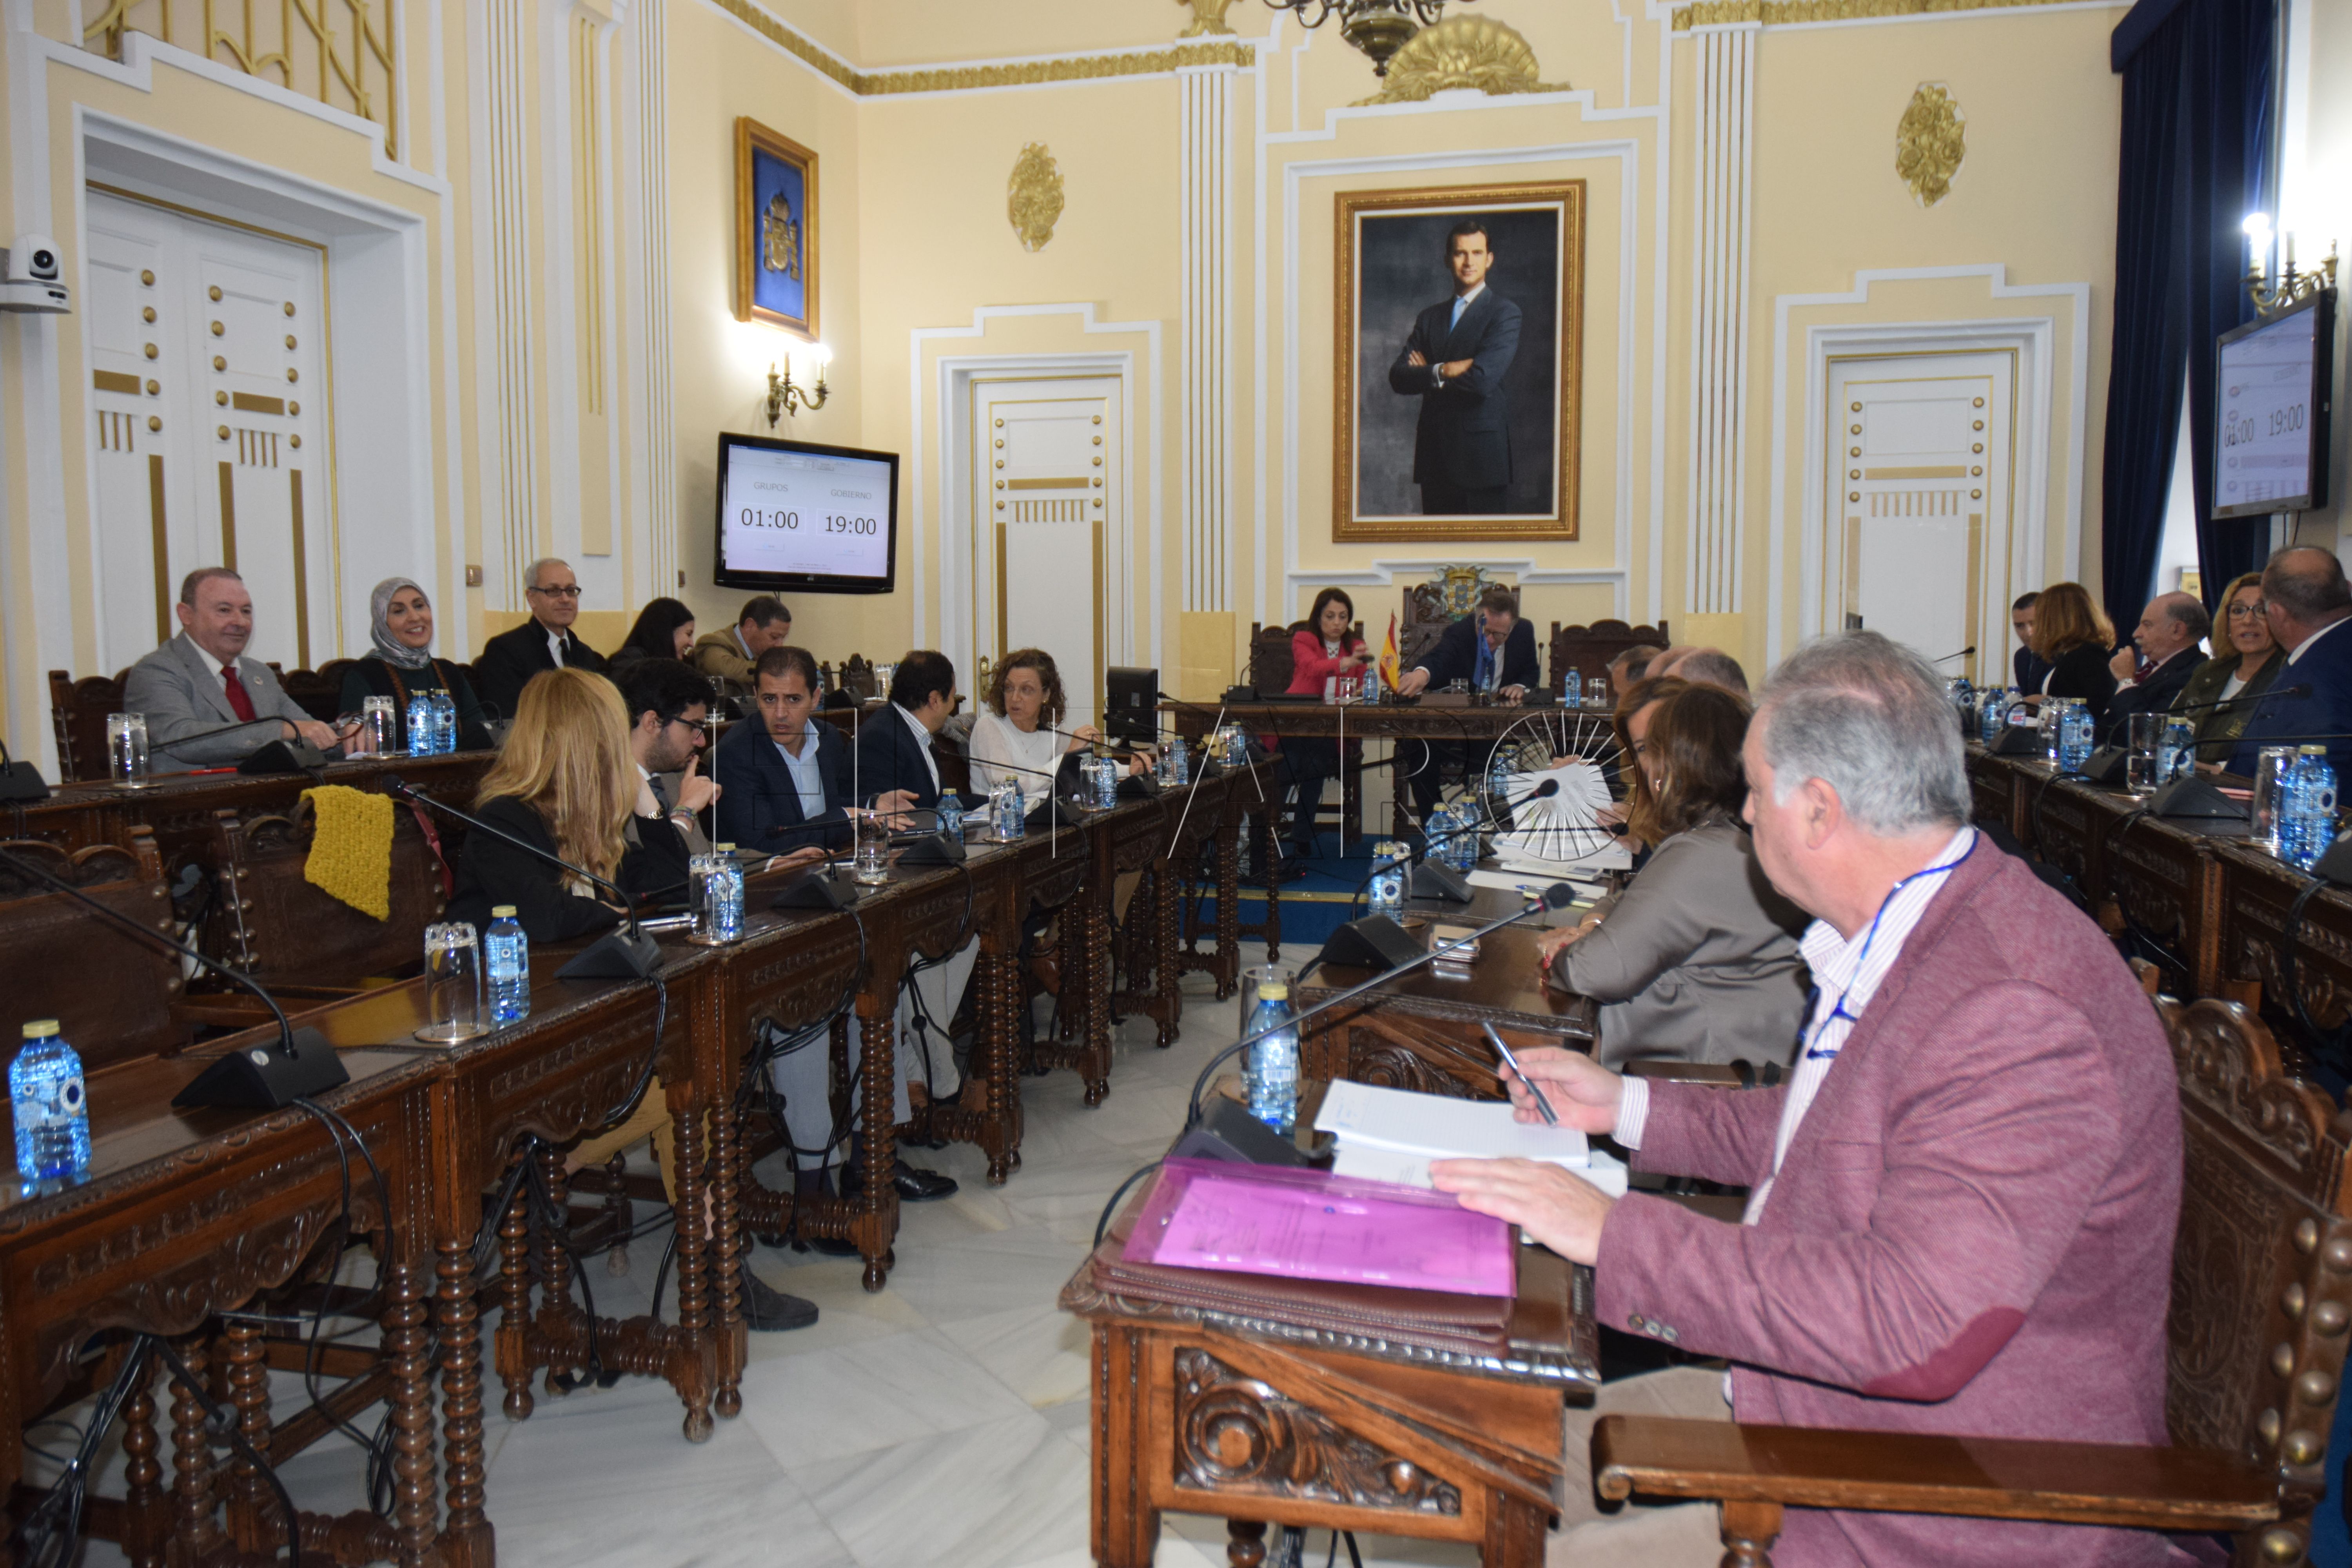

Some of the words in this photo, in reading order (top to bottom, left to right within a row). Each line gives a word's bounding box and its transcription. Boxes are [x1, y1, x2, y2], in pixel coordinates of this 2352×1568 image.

[2269, 403, 2303, 436] 19:00
[753, 481, 788, 492] GRUPOS
[831, 489, 872, 500] GOBIERNO
[741, 508, 798, 529] 01:00
[825, 515, 876, 535] 19:00
